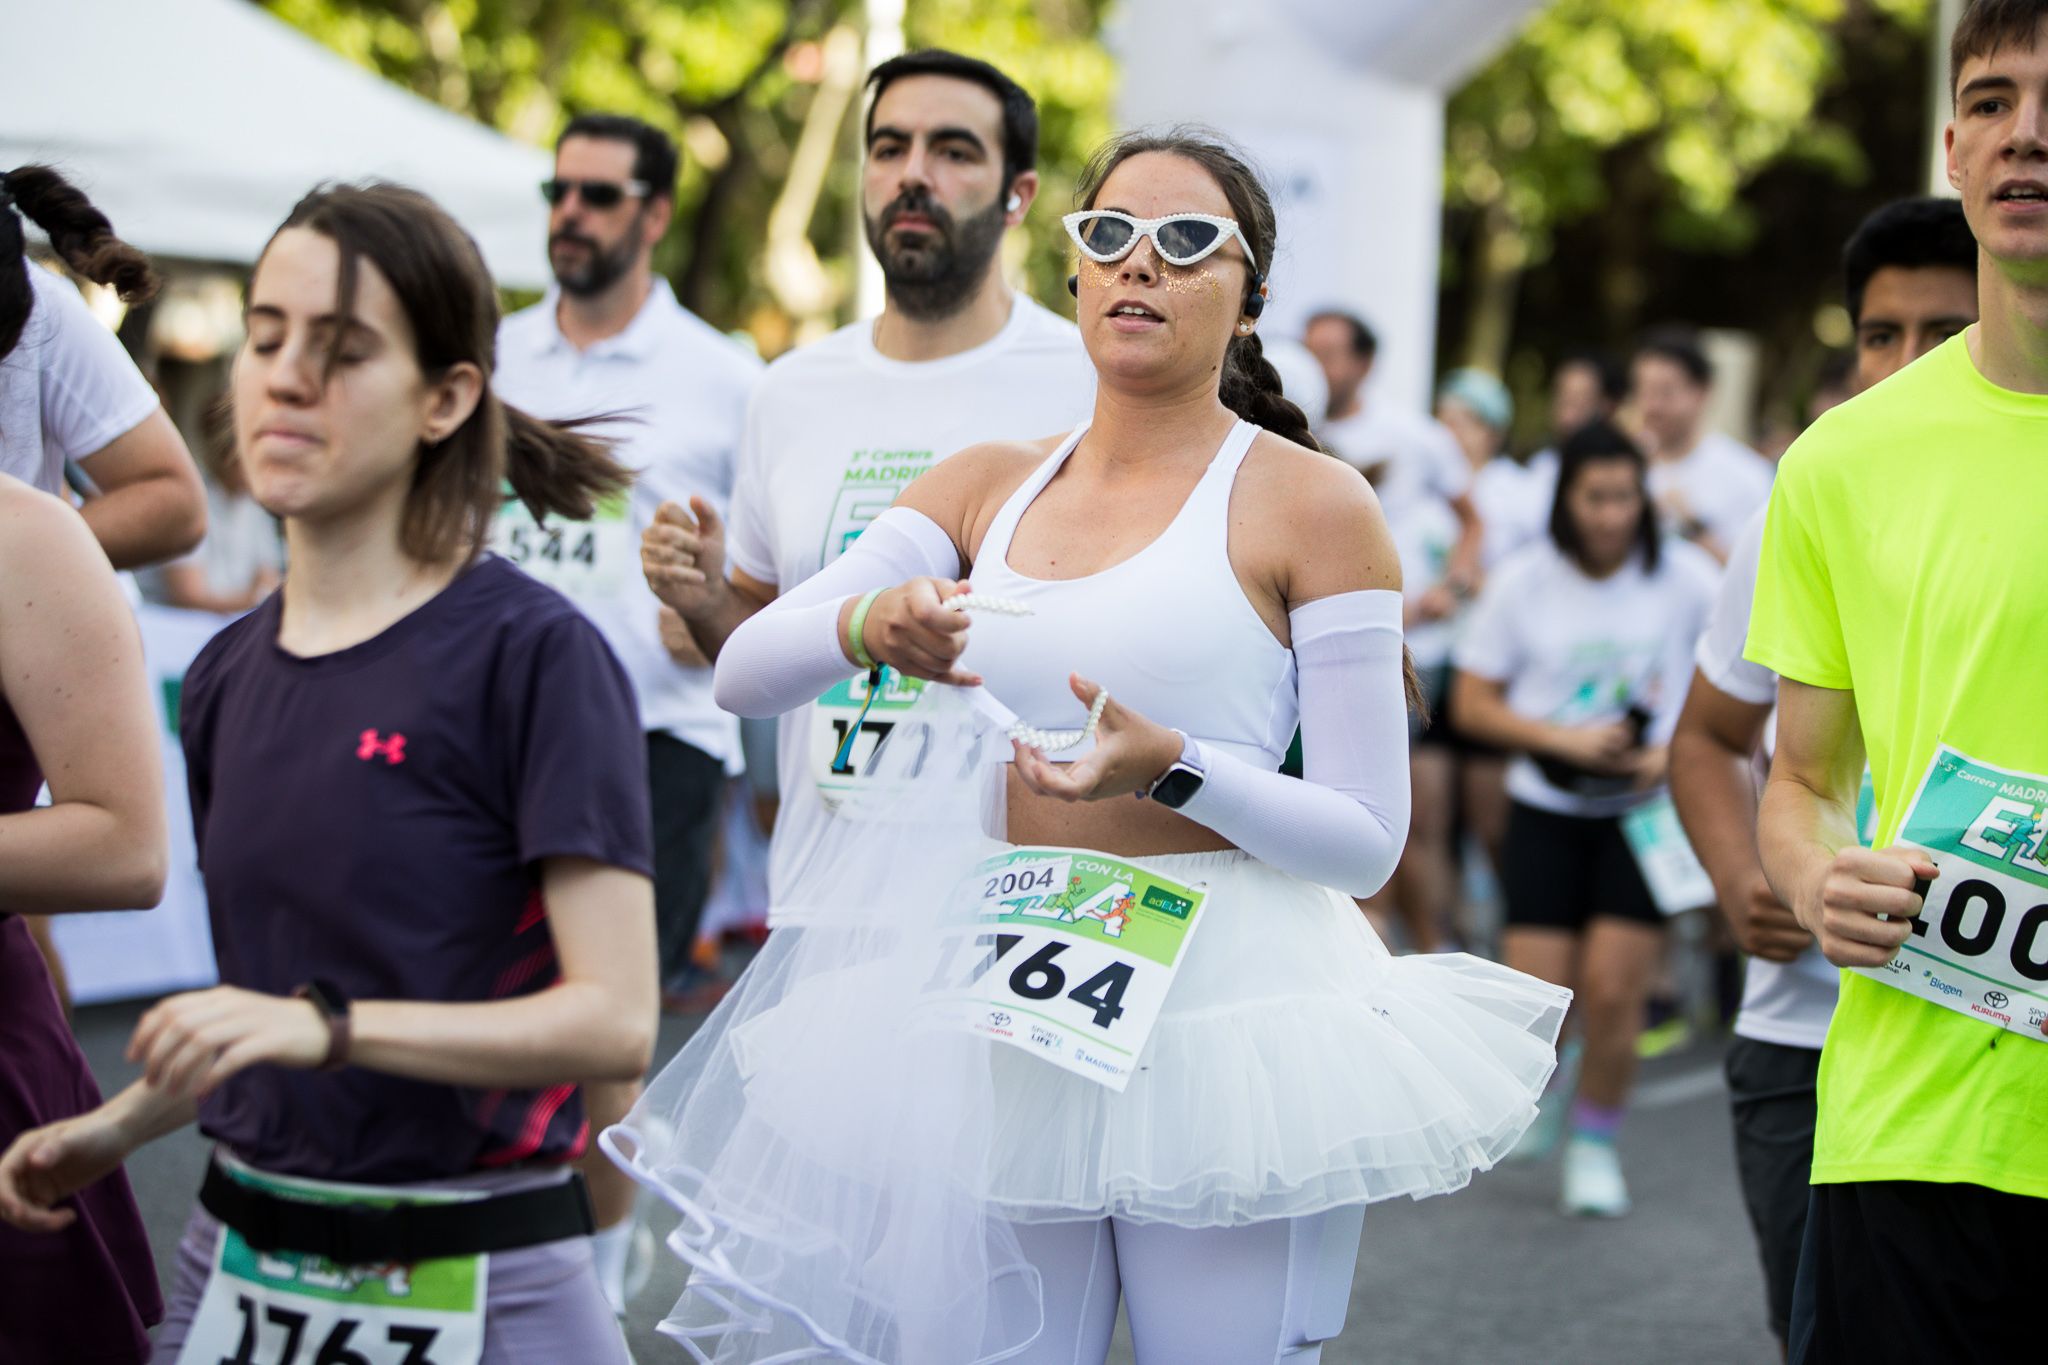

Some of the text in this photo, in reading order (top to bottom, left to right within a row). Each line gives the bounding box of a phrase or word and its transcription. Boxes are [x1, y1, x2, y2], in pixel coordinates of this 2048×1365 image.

[1956, 769, 1998, 790] Carrera
[1998, 781, 2048, 804] MADR
[984, 866, 1055, 899] 2004
[1075, 859, 1113, 877] CON
[1112, 869, 1135, 885] LA
[920, 933, 1136, 1030] 1764
[1929, 976, 1963, 998] Biogen
[1031, 1034, 1051, 1048] LIFE
[1084, 1055, 1119, 1075] MADRID
